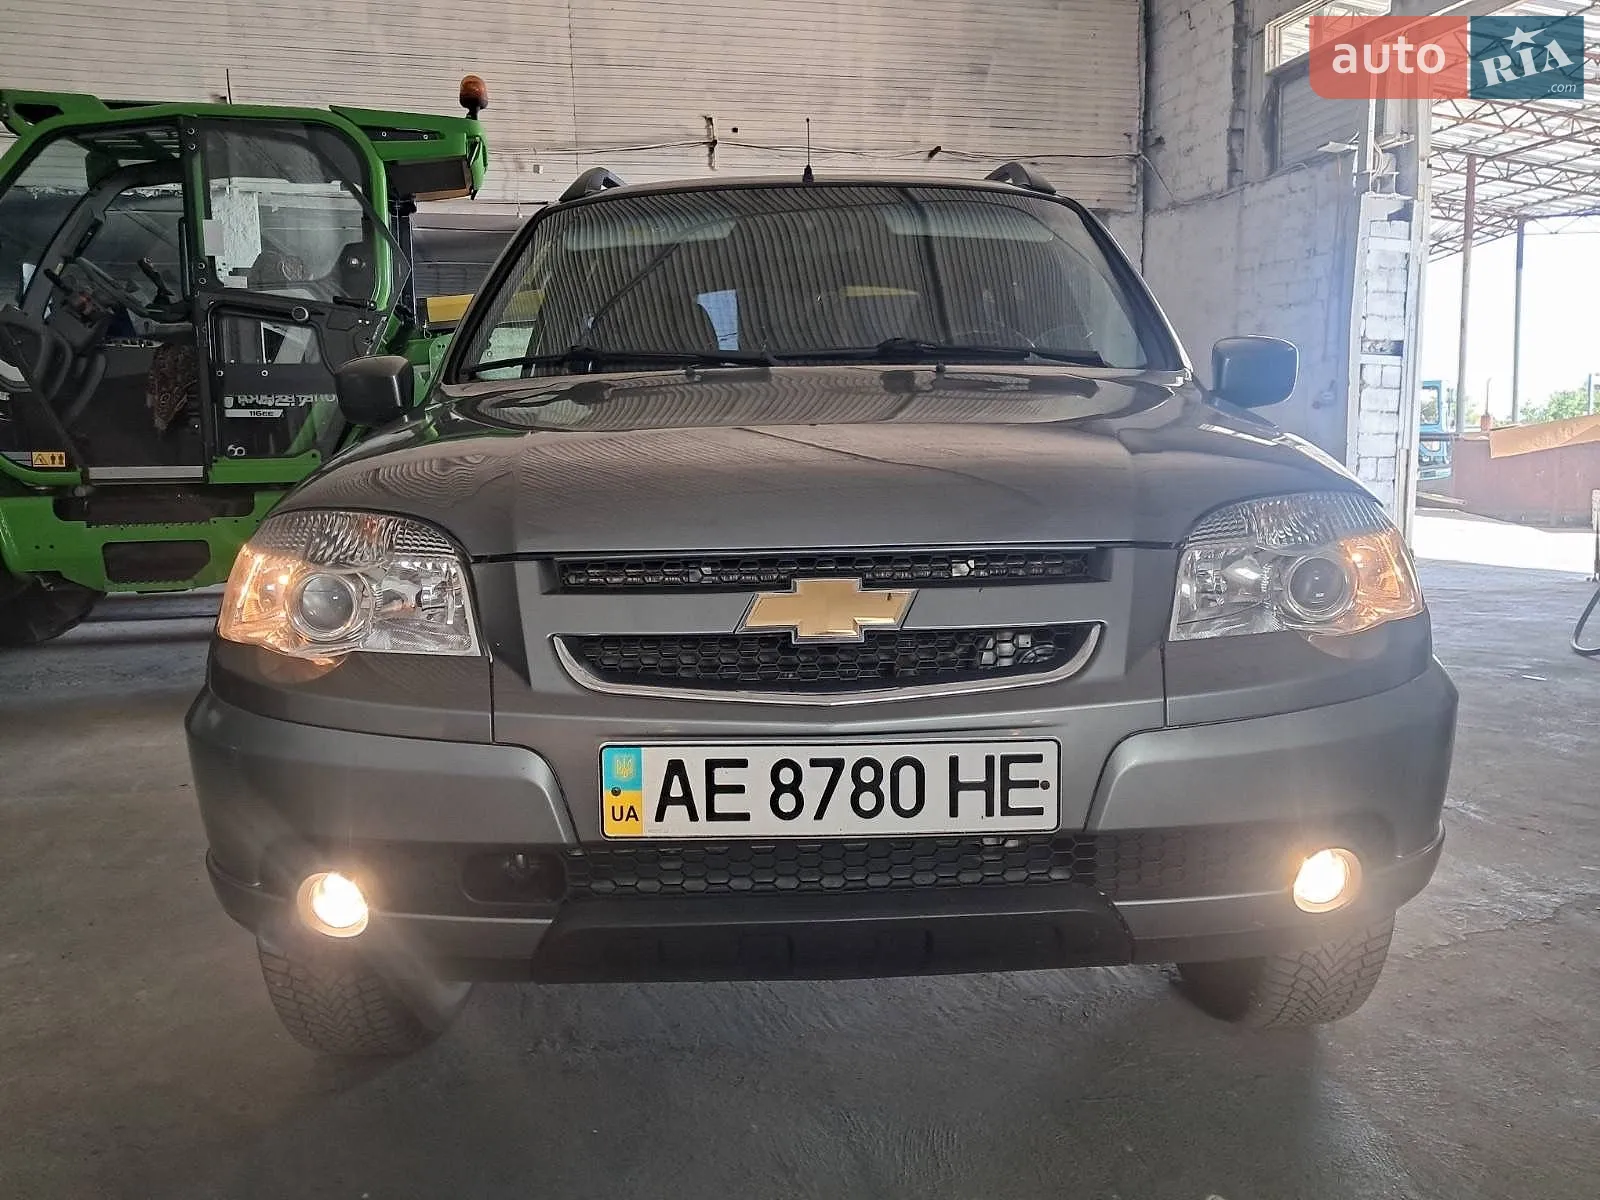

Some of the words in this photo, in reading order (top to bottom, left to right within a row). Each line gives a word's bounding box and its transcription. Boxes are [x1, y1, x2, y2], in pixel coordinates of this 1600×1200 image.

[654, 758, 752, 823] AE
[769, 755, 926, 821] 8780
[948, 753, 1045, 818] HE
[611, 805, 639, 822] UA
